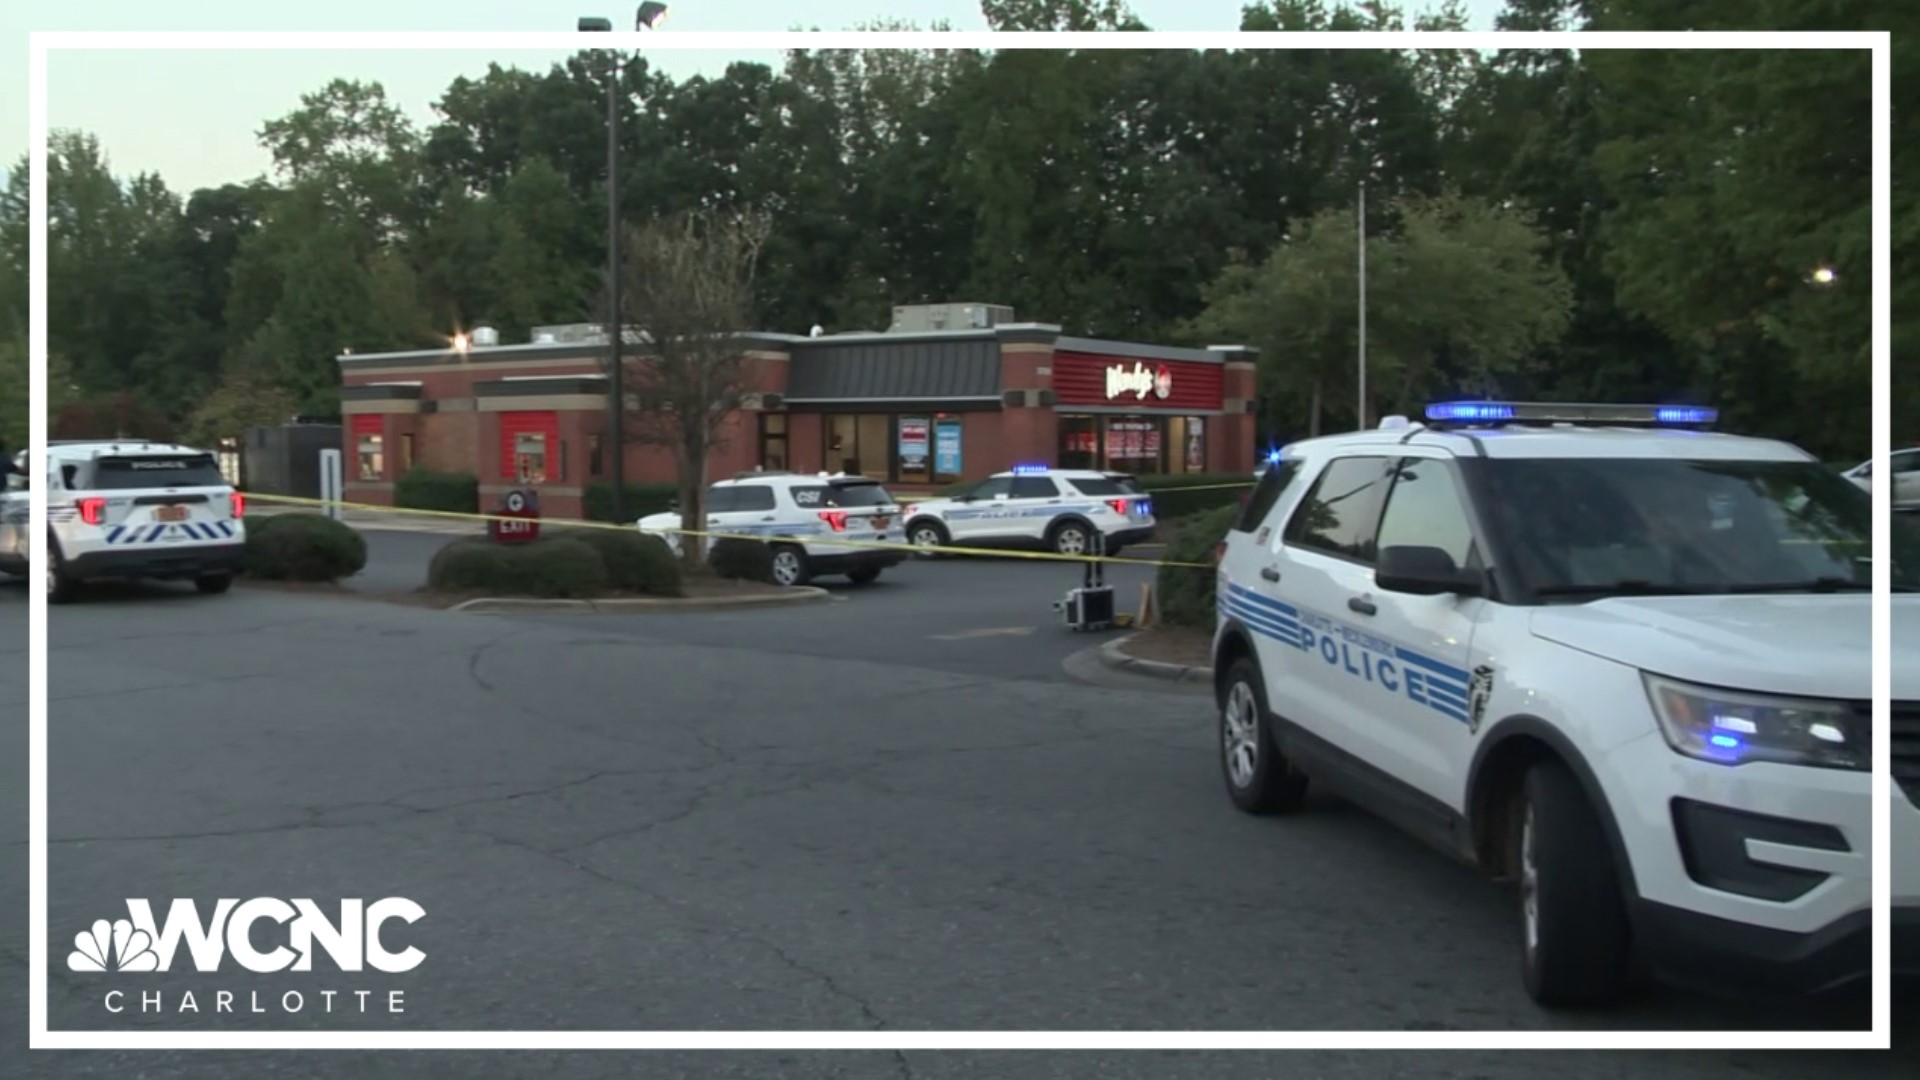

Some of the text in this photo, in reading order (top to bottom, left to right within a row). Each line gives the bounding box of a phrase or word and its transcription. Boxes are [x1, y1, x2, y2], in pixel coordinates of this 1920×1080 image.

[796, 490, 821, 503] CSI
[500, 519, 530, 533] EXIT
[1300, 626, 1427, 705] POLICE
